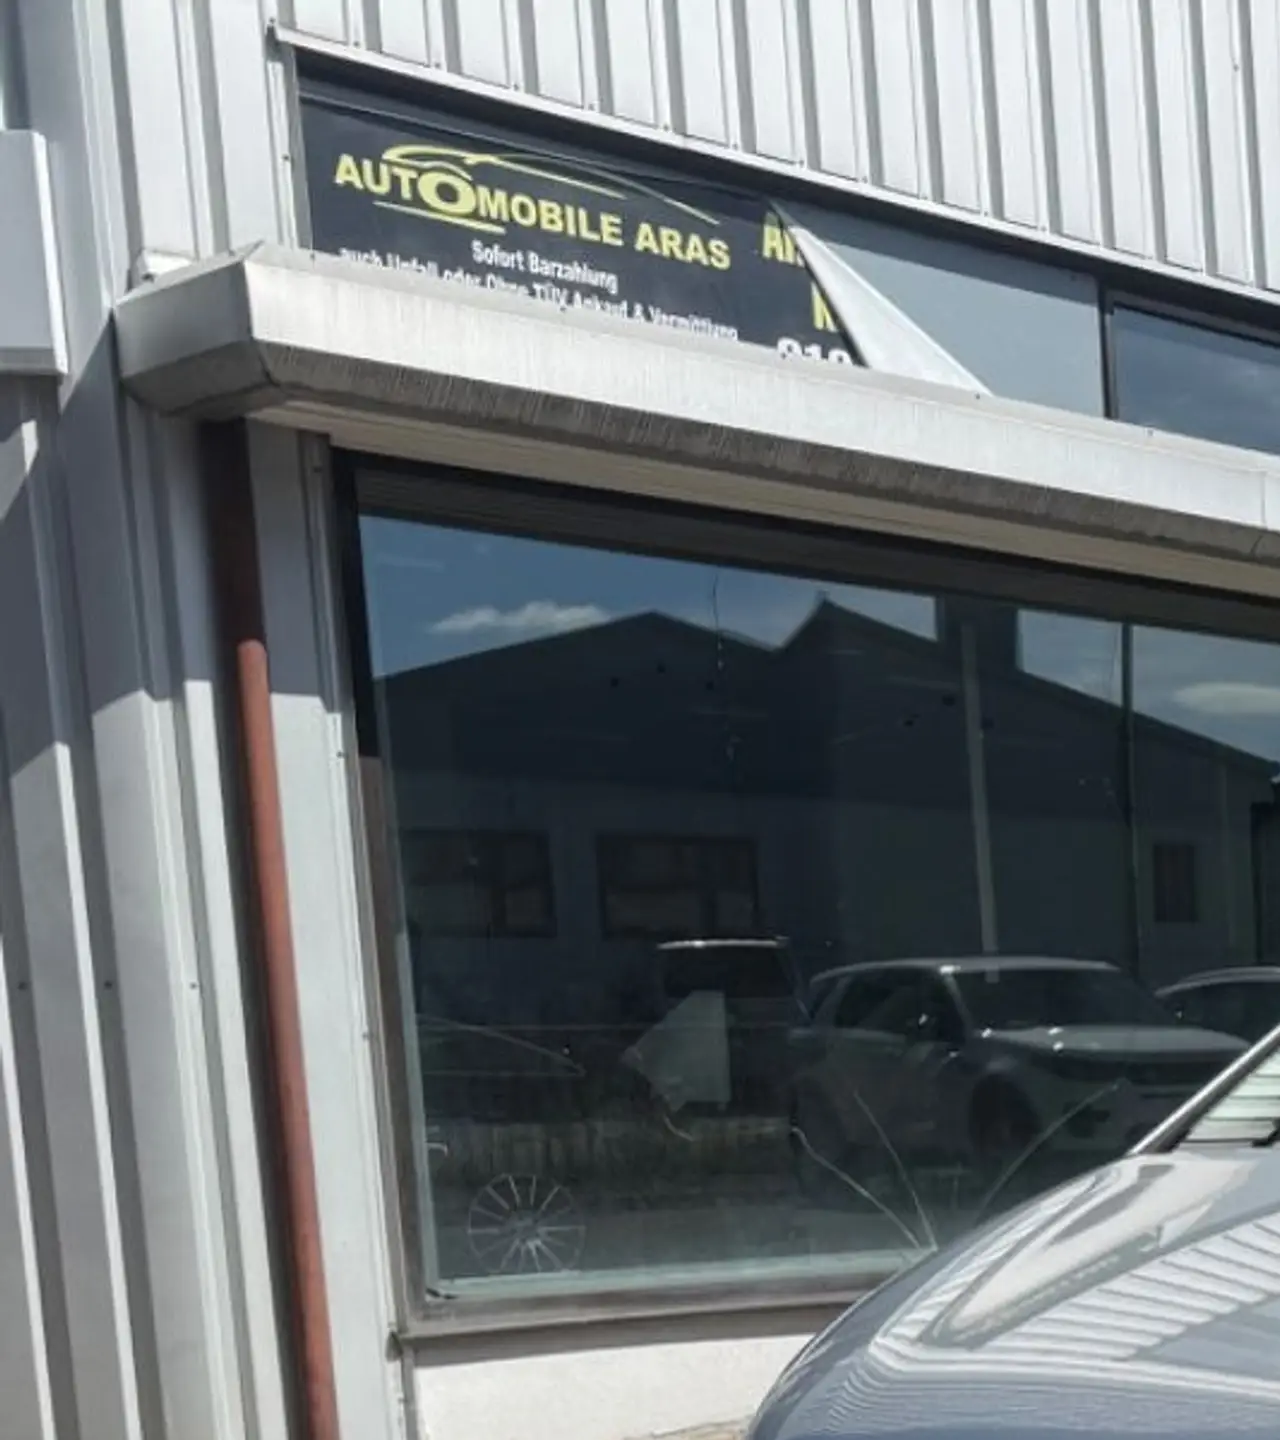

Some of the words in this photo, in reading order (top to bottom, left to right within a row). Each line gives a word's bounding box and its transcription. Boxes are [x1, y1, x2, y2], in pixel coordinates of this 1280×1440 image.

[335, 153, 624, 246] AUTOMOBILE
[634, 222, 731, 270] ARAS
[471, 238, 524, 272] Sofort
[529, 251, 618, 295] Barzahlung
